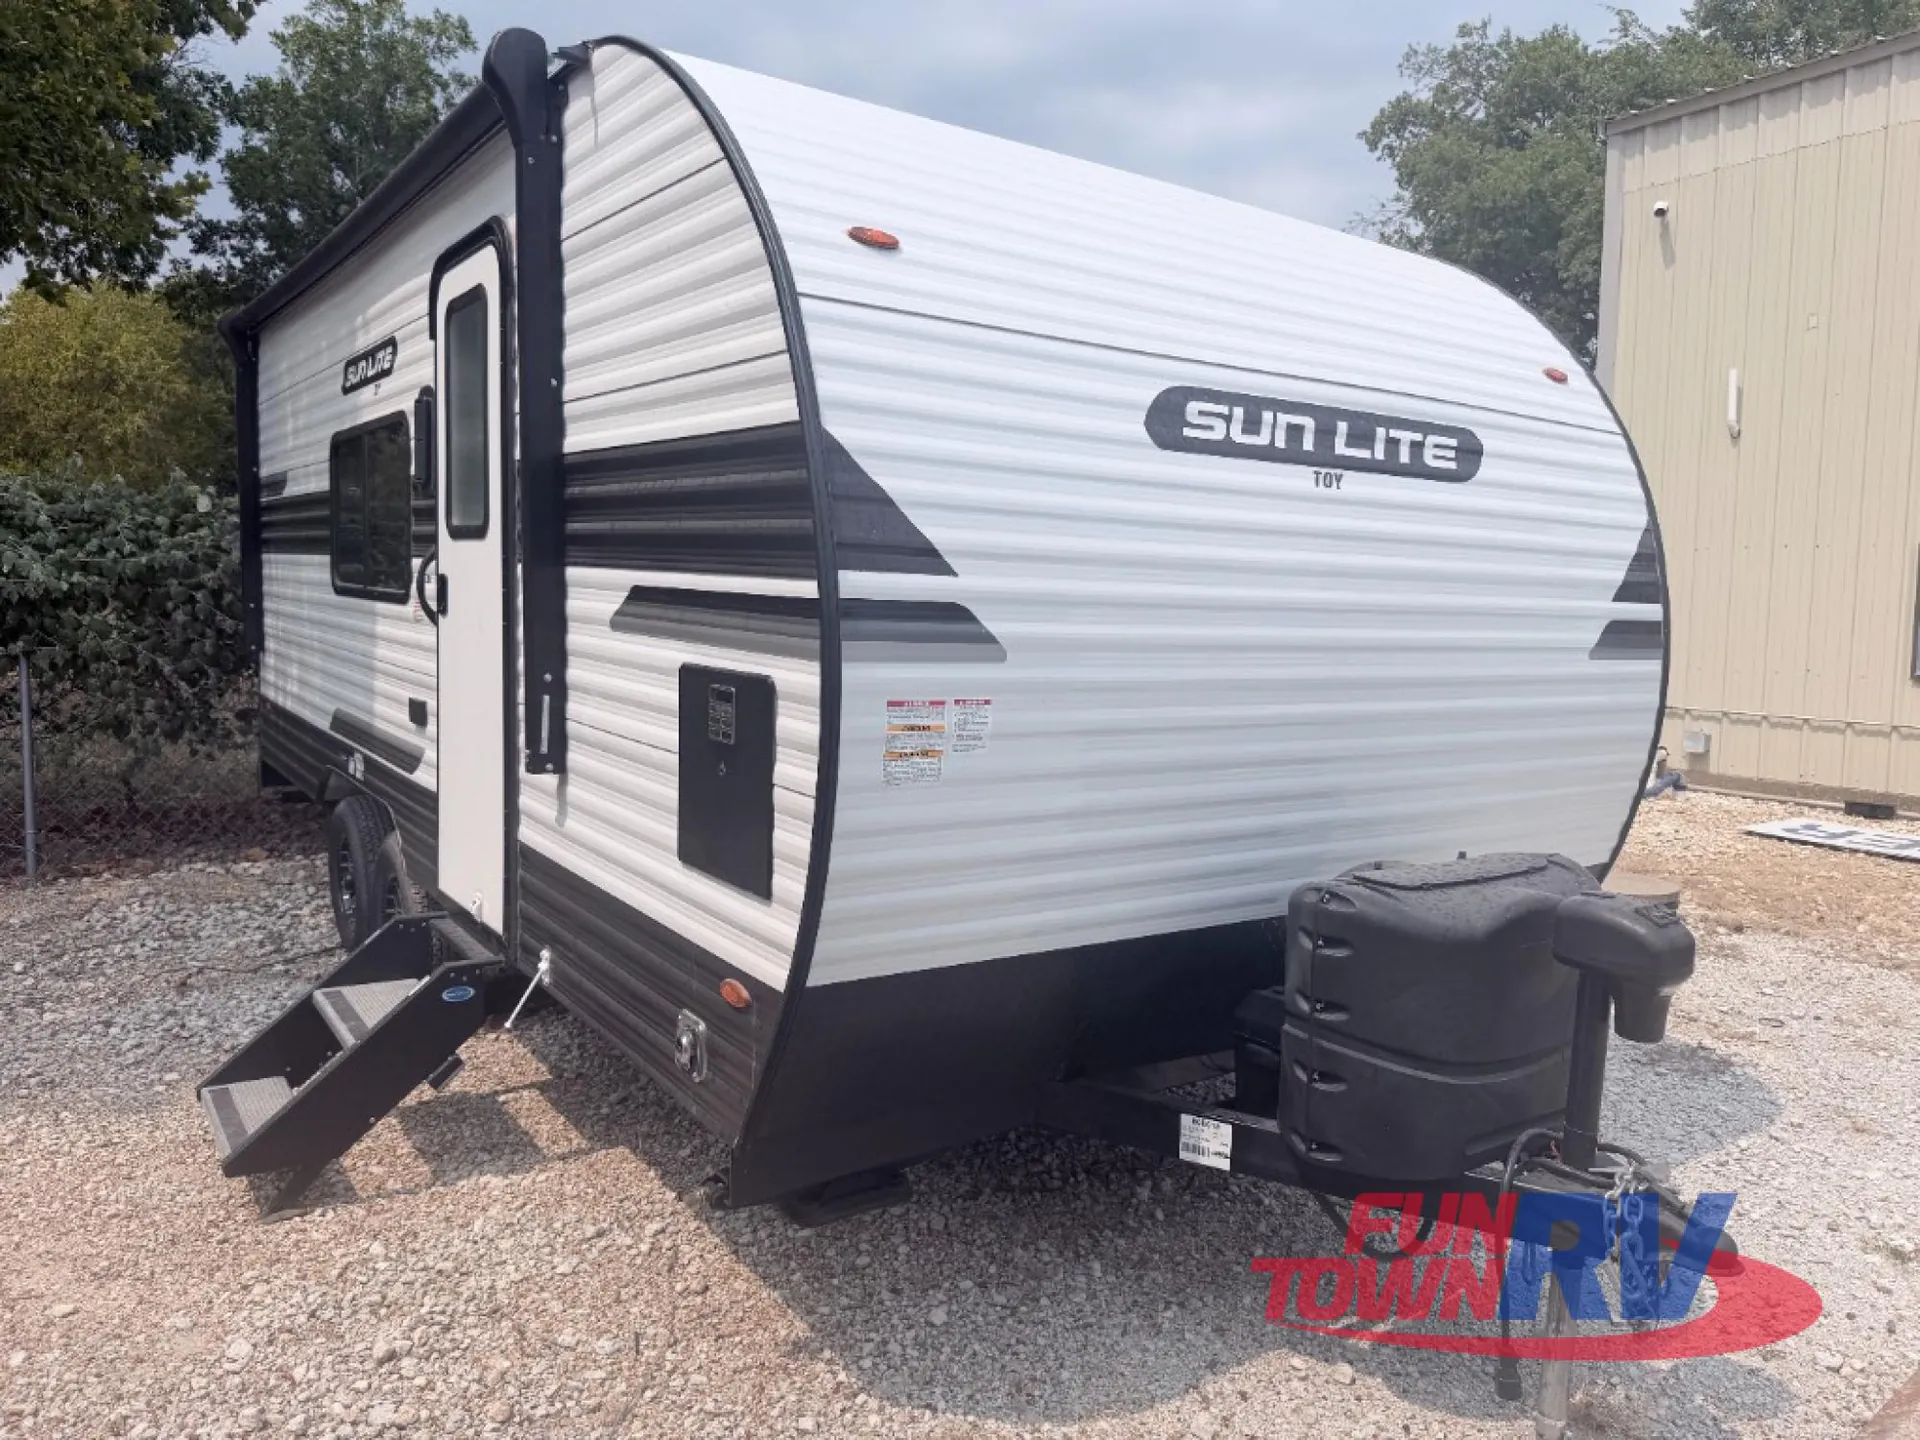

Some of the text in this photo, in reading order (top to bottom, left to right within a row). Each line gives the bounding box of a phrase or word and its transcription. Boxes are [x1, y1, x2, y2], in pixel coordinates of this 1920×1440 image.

[1182, 400, 1458, 470] SUN LITE
[1313, 470, 1343, 490] TOY
